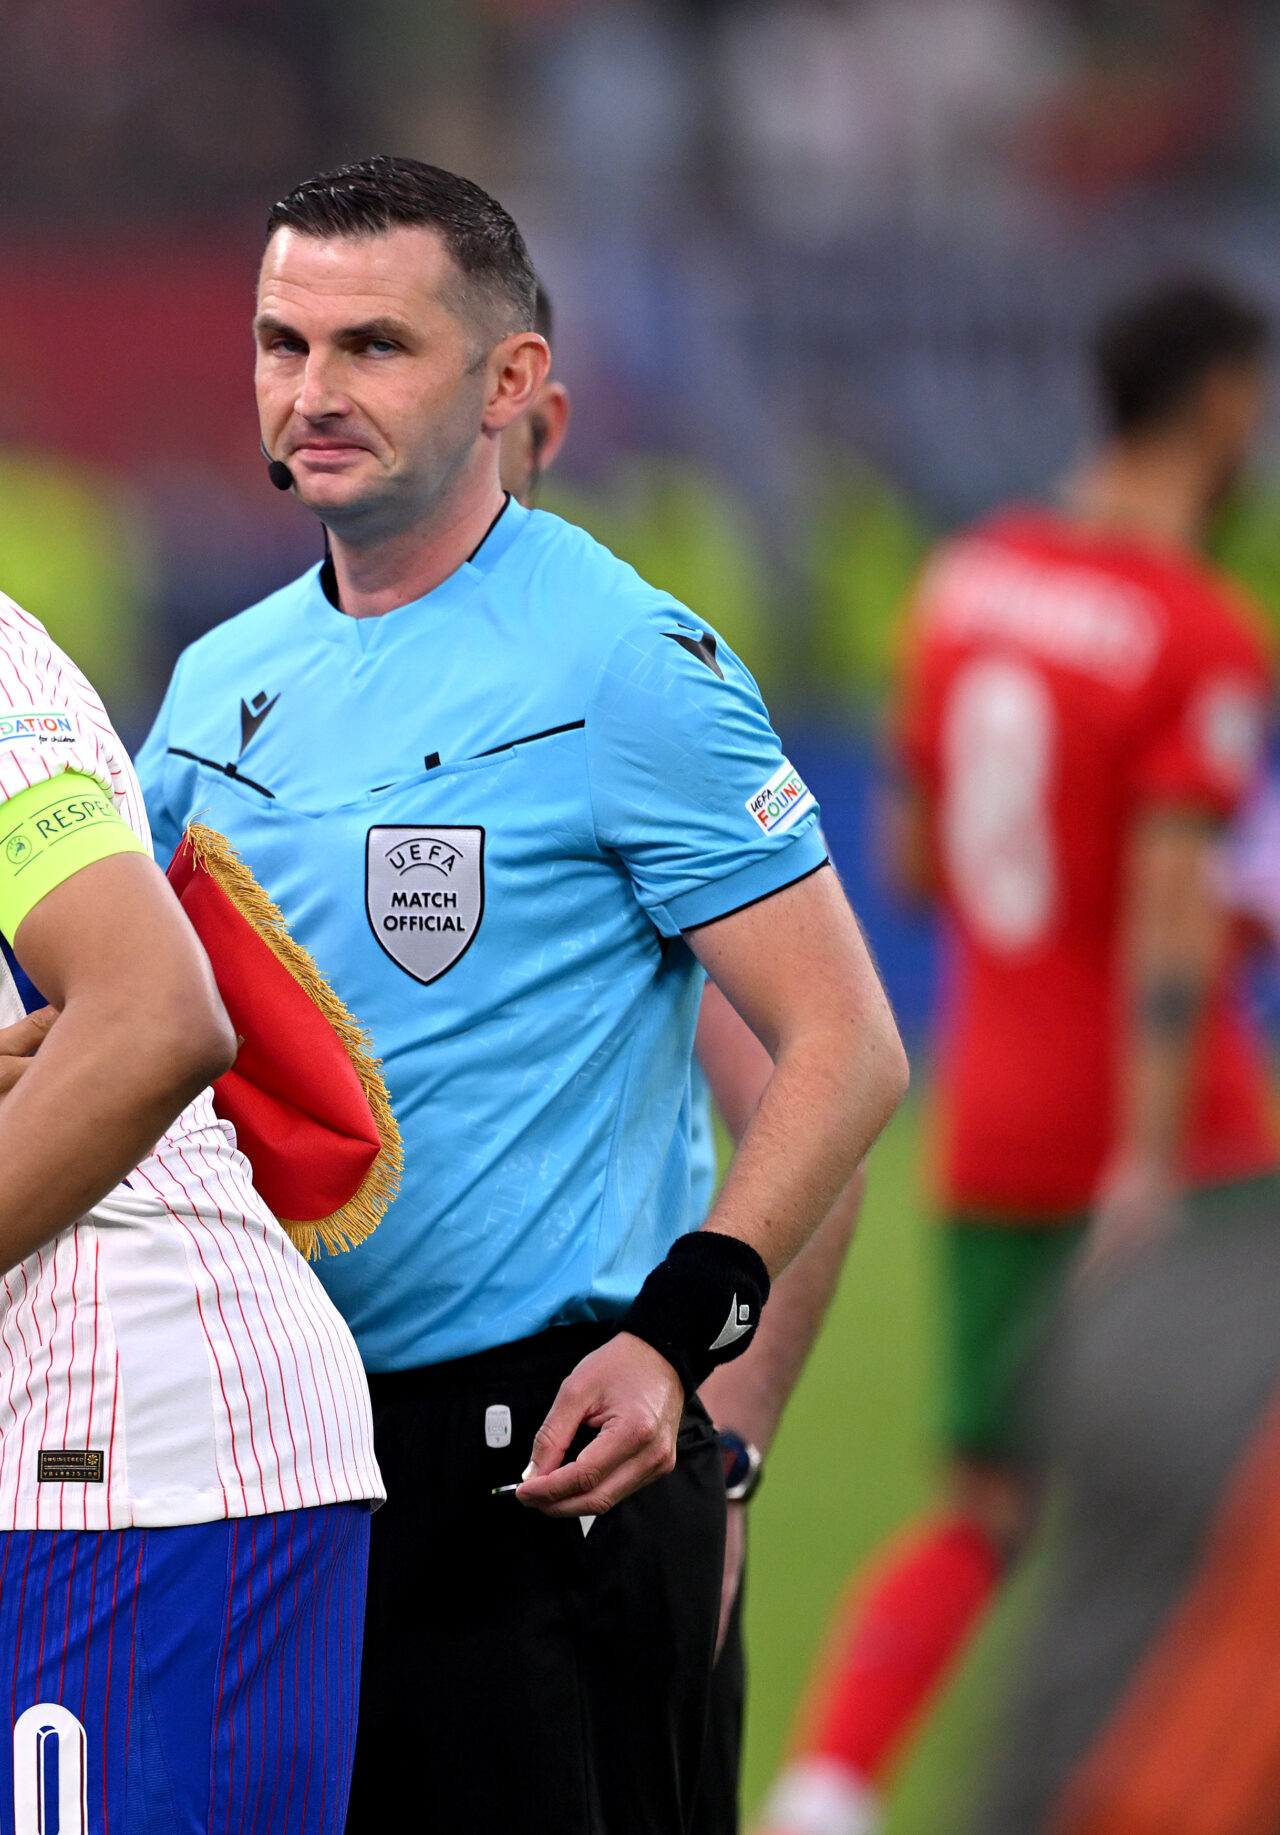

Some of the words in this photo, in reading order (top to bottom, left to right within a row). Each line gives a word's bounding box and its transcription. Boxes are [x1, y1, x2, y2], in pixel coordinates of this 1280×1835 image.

[750, 788, 774, 812] UEFA
[389, 844, 456, 872] UEFA
[391, 892, 457, 908] MATCH
[383, 915, 465, 931] OFFICIAL
